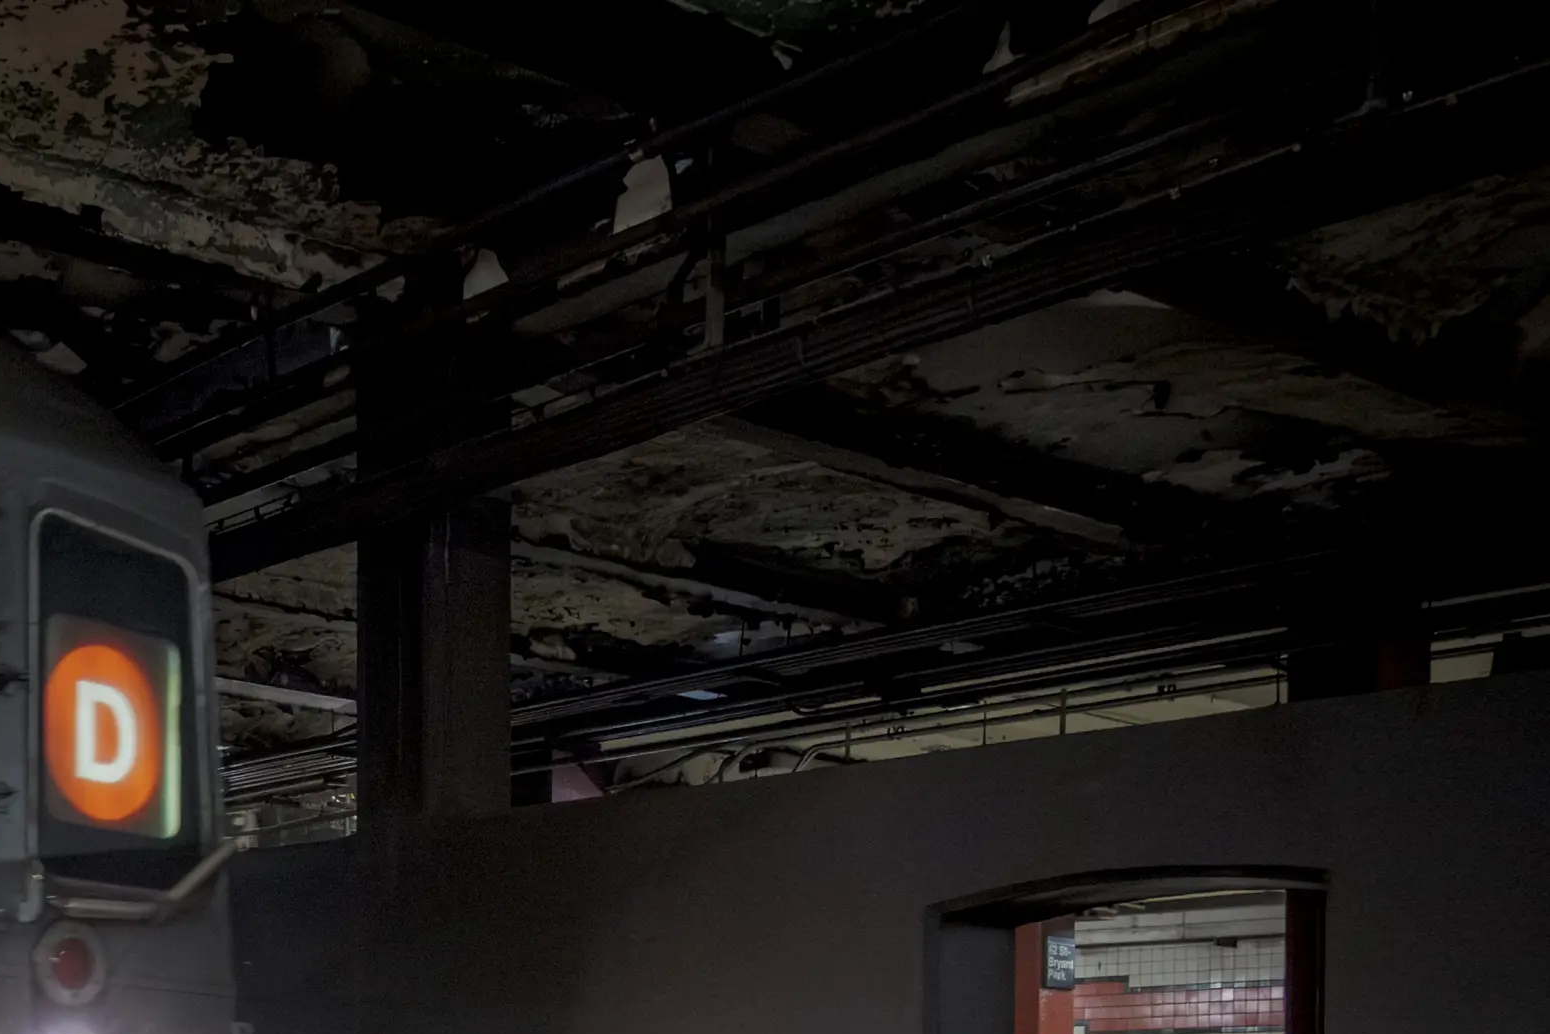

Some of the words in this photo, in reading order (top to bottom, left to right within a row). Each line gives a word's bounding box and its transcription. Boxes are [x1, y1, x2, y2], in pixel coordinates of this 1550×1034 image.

[74, 679, 137, 784] D
[1048, 956, 1074, 971] Bryant
[1048, 969, 1067, 981] Park
